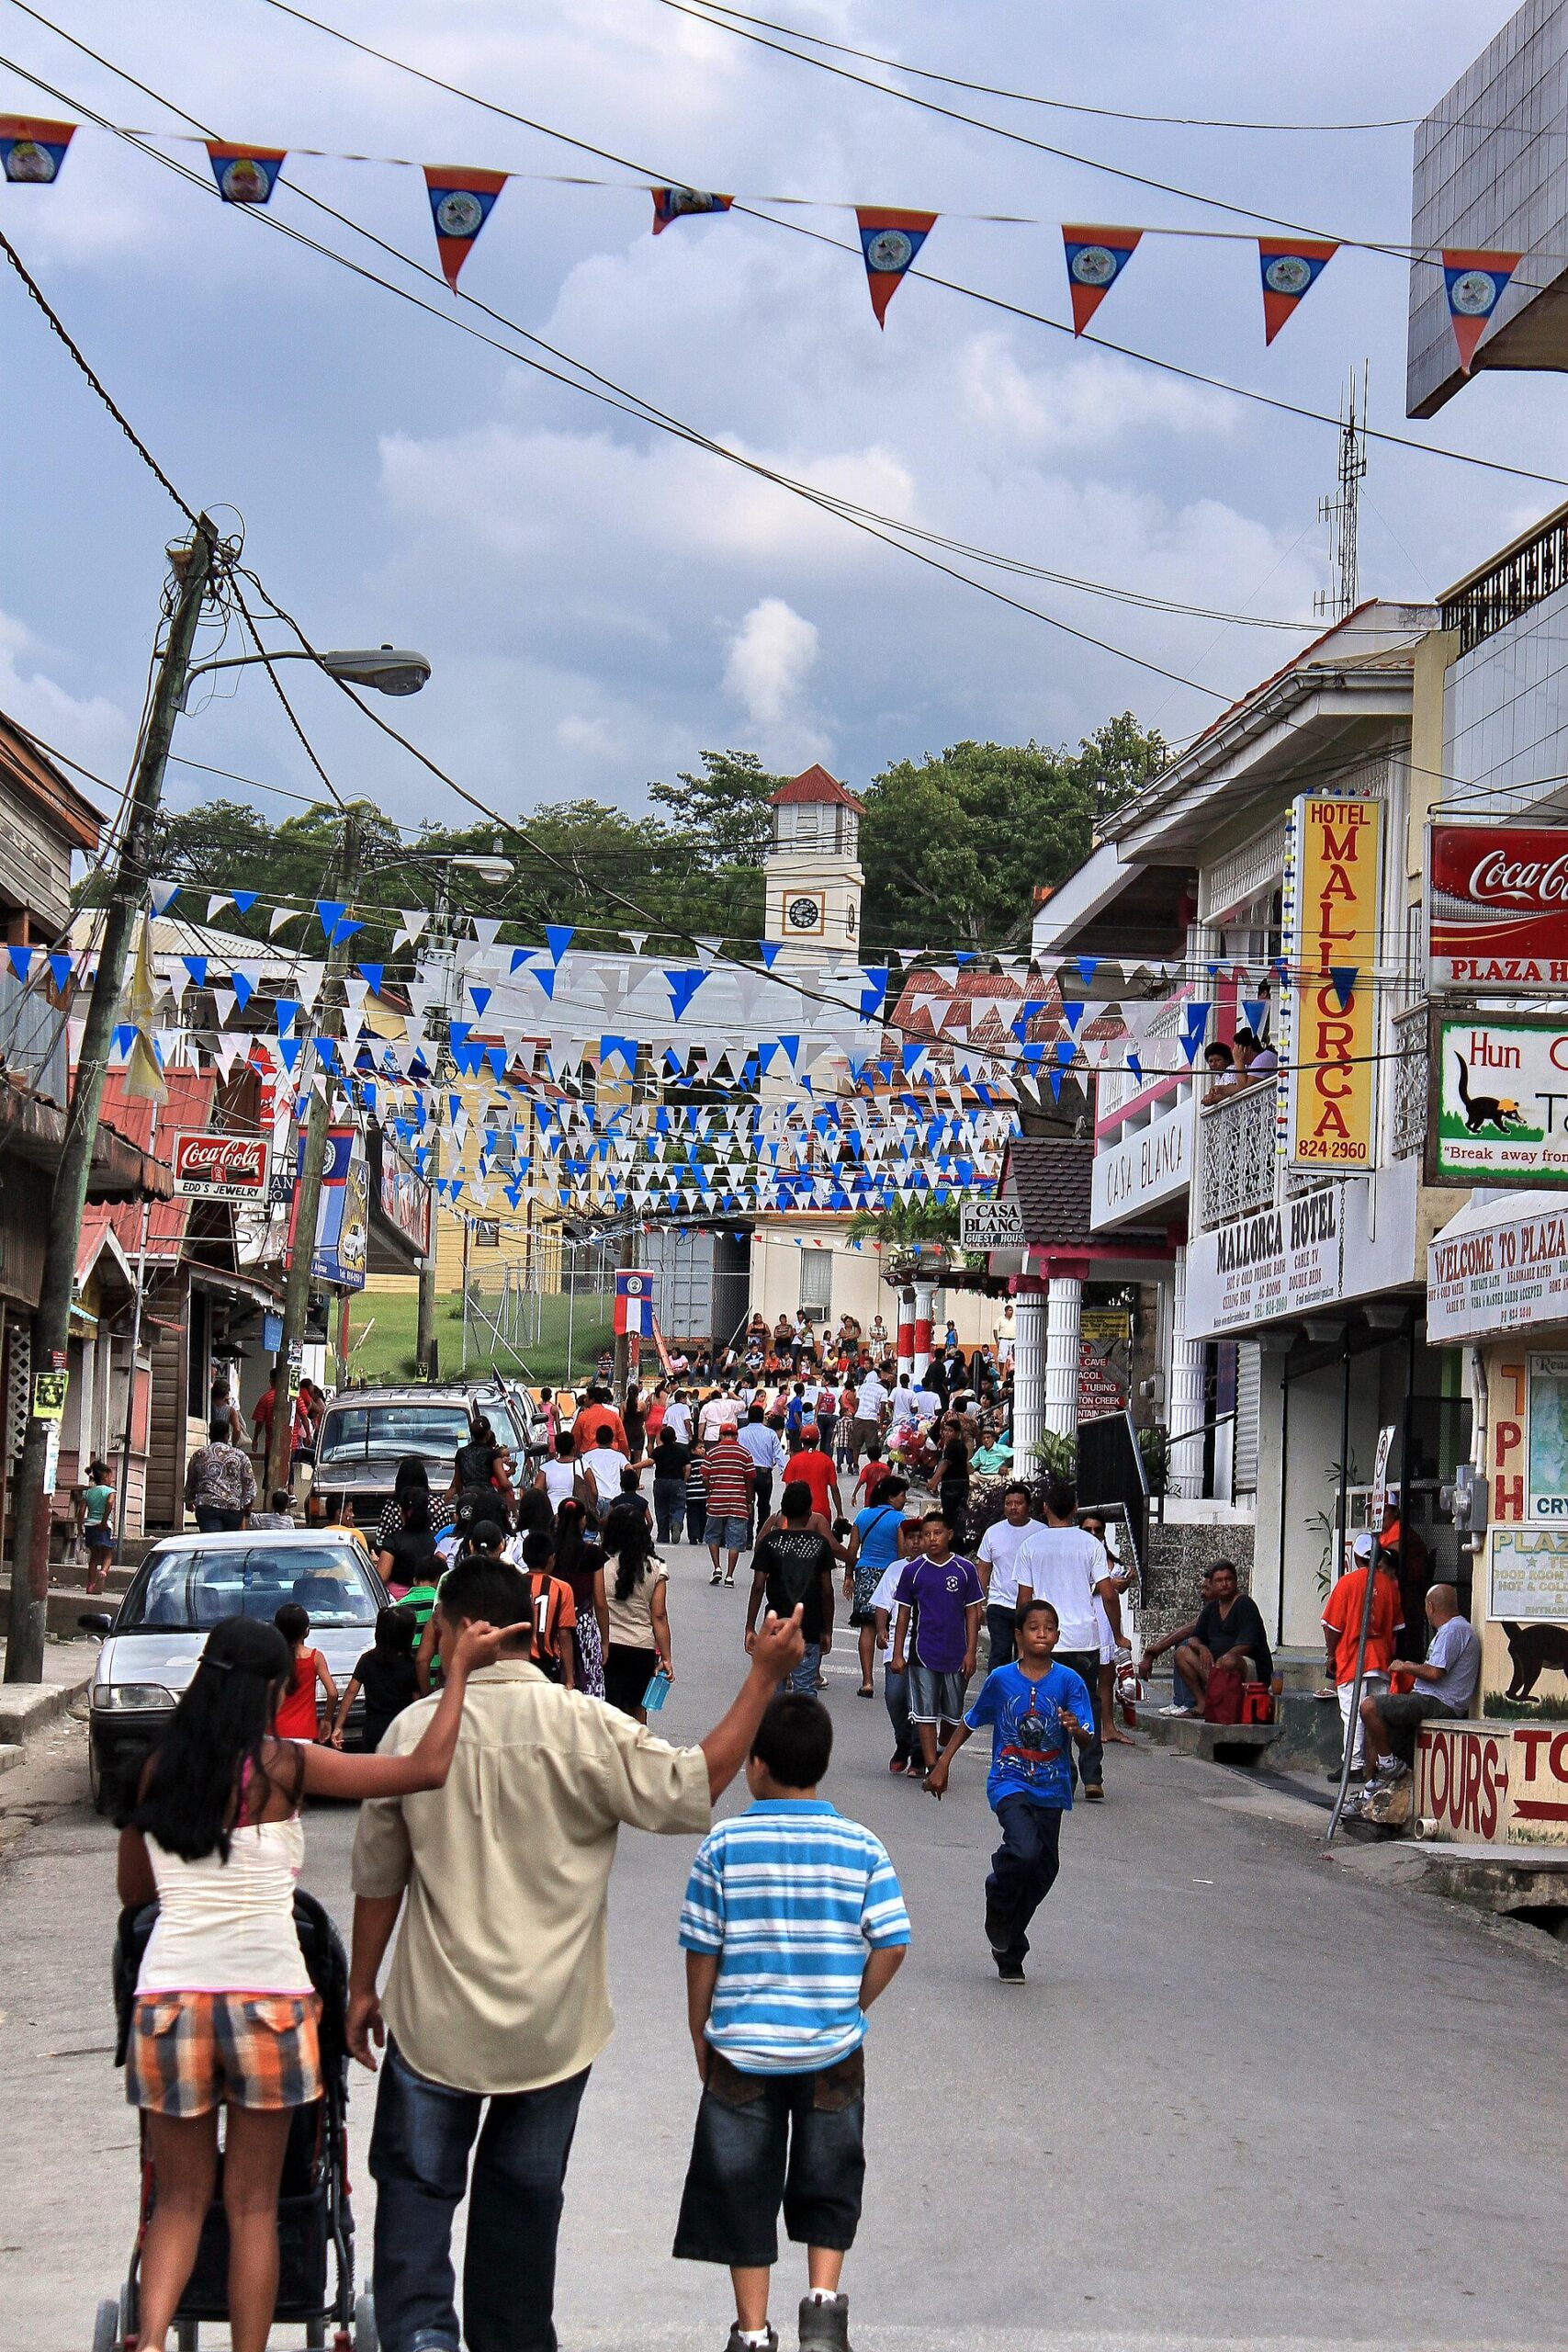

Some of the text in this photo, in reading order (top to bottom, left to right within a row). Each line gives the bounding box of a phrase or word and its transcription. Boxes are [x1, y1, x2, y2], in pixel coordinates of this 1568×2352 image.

[1311, 803, 1371, 826] HOTEL
[1450, 960, 1543, 981] PLAZA
[1469, 1031, 1522, 1070] Hun
[1534, 1091, 1568, 1134] T
[180, 1140, 261, 1170] Coca-Cola
[1107, 1124, 1183, 1206] CASA BLANCA
[1501, 1150, 1538, 1164] away
[182, 1182, 259, 1198] EDD'S JEWELRY
[976, 1204, 1019, 1218] CASA
[965, 1233, 1026, 1243] GUEST HOUS
[1216, 1191, 1337, 1276] MALLORCA HOTEL
[1434, 1218, 1567, 1284] WELCOME TO PLAZA
[1254, 1262, 1272, 1282] PRIVATE
[1294, 1250, 1310, 1270] CABLE
[1312, 1248, 1319, 1265] TV
[1288, 1272, 1308, 1292] DOUBLE
[1308, 1268, 1322, 1286] BEDS
[1471, 1276, 1489, 1293] PRIVATE
[1489, 1274, 1501, 1289] BATH
[1506, 1266, 1536, 1284] REASONABLE
[1536, 1263, 1551, 1280] RATES
[1446, 1299, 1459, 1315] CABLE
[1471, 1295, 1482, 1309] VISA
[1505, 1289, 1518, 1304] CARDS
[1519, 1283, 1542, 1301] ACCEPTED
[1084, 1358, 1107, 1366] CAVE
[1085, 1383, 1117, 1392] TUBING
[1095, 1396, 1120, 1405] CREEK
[1498, 1580, 1524, 1591] HOT
[1416, 1731, 1499, 1840] TOURS
